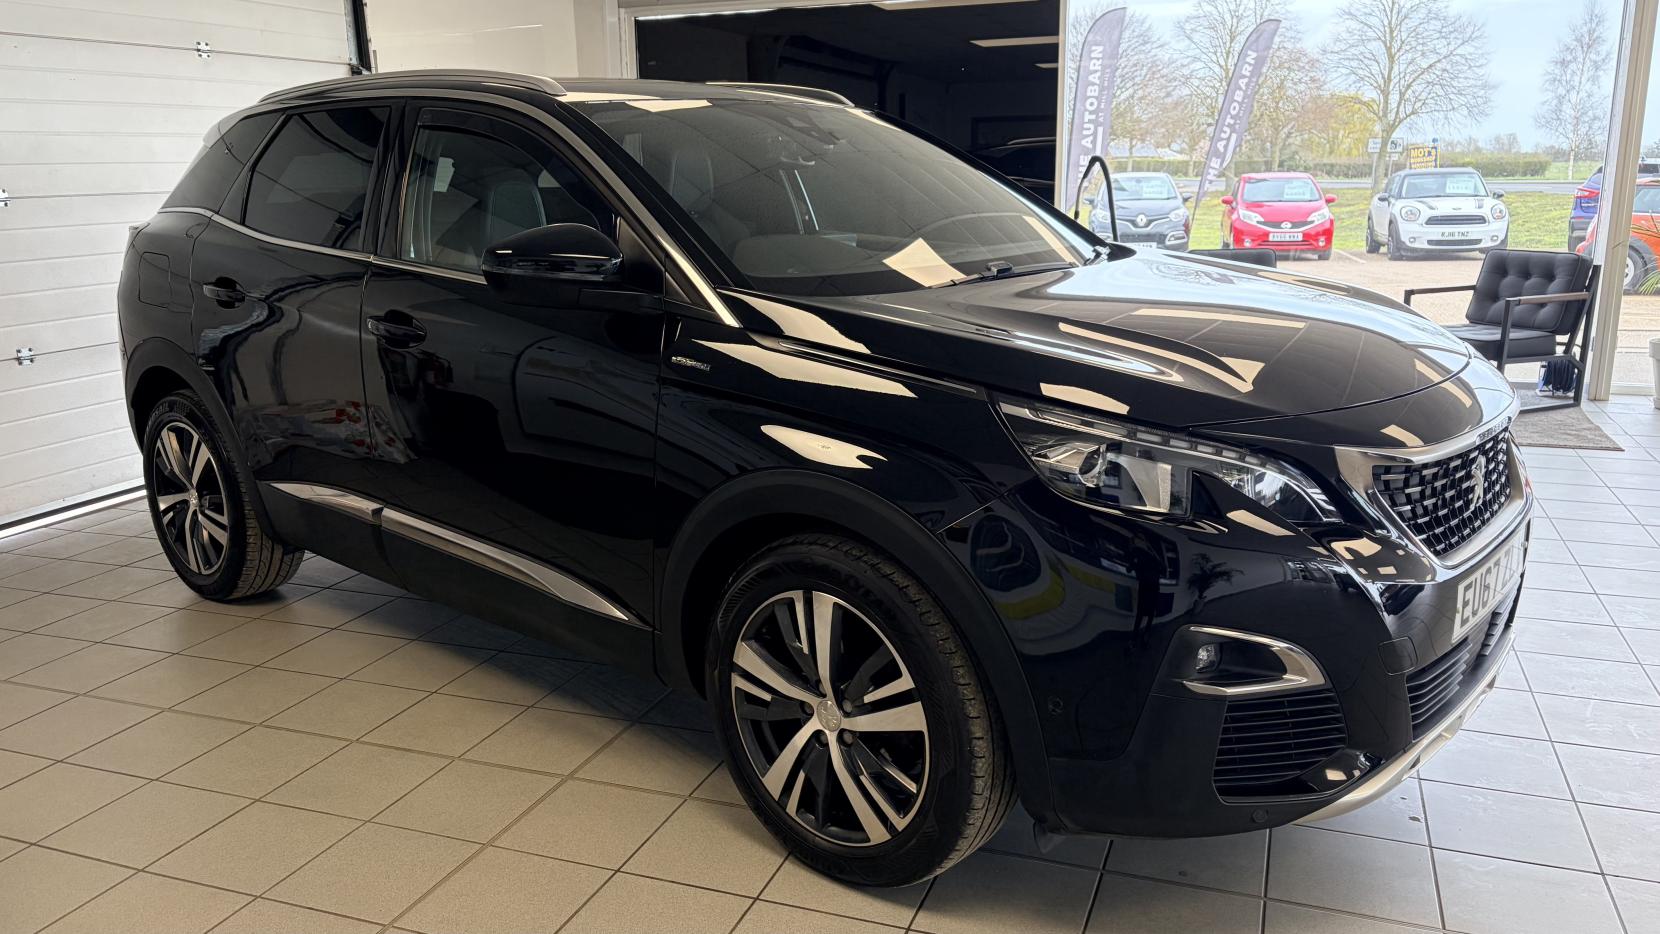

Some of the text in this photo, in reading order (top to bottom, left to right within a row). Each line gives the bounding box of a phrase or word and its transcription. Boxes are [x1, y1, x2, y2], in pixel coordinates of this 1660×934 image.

[1081, 45, 1104, 148] AUTOBARN
[1204, 49, 1258, 191] THE AUTOBARN
[1460, 557, 1501, 629] EU67
